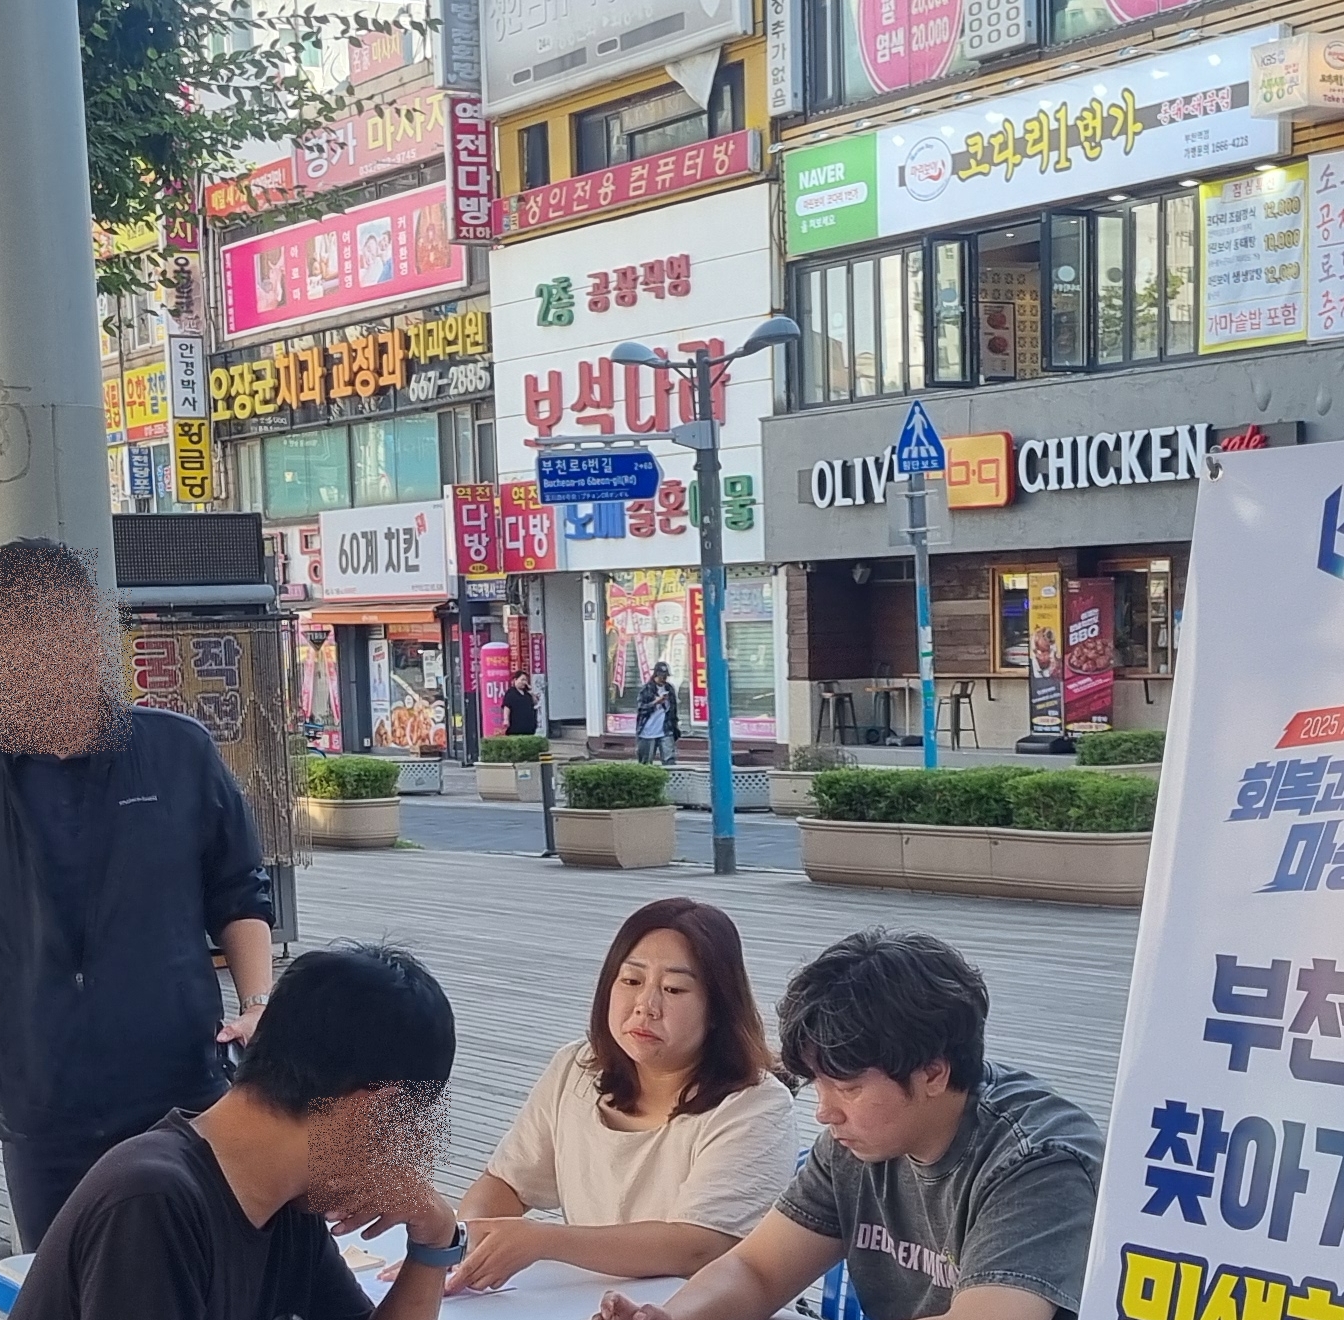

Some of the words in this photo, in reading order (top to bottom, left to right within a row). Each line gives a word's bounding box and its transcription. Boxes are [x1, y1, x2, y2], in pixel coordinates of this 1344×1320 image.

[876, 28, 905, 64] 염색
[910, 16, 950, 51] 20,000
[958, 88, 1144, 182] 코다리1번가
[455, 102, 493, 224] 역전다방
[524, 174, 618, 225] 성인전용
[628, 140, 736, 198] 컴퓨터방
[798, 162, 846, 190] NAVER
[1263, 195, 1302, 220] 12,000
[458, 226, 492, 240] 지하
[1263, 228, 1301, 252] 10,000
[586, 253, 692, 313] 공장직영
[1263, 261, 1301, 285] 12,000
[1207, 307, 1263, 337] 가마솥밥
[1266, 302, 1299, 328] 포함
[178, 342, 198, 412] 안경박사
[210, 359, 278, 421] 오장균
[408, 311, 492, 365] 치과의원
[408, 362, 491, 402] 667-2885
[523, 337, 732, 448] 보석나라
[178, 421, 209, 499] 황금당
[541, 457, 613, 476] 부천로6번길
[902, 459, 940, 471] 횡단보도
[1018, 422, 1209, 494] CHICKEN
[456, 485, 491, 502] 역전
[511, 484, 542, 509] 역전
[338, 529, 379, 576] 60계
[384, 525, 420, 574] 치킨
[462, 503, 491, 562] 다방
[505, 513, 551, 558] 다방
[1069, 624, 1099, 647] BBQ
[1299, 713, 1340, 739] 2025
[897, 1240, 922, 1271] EX
